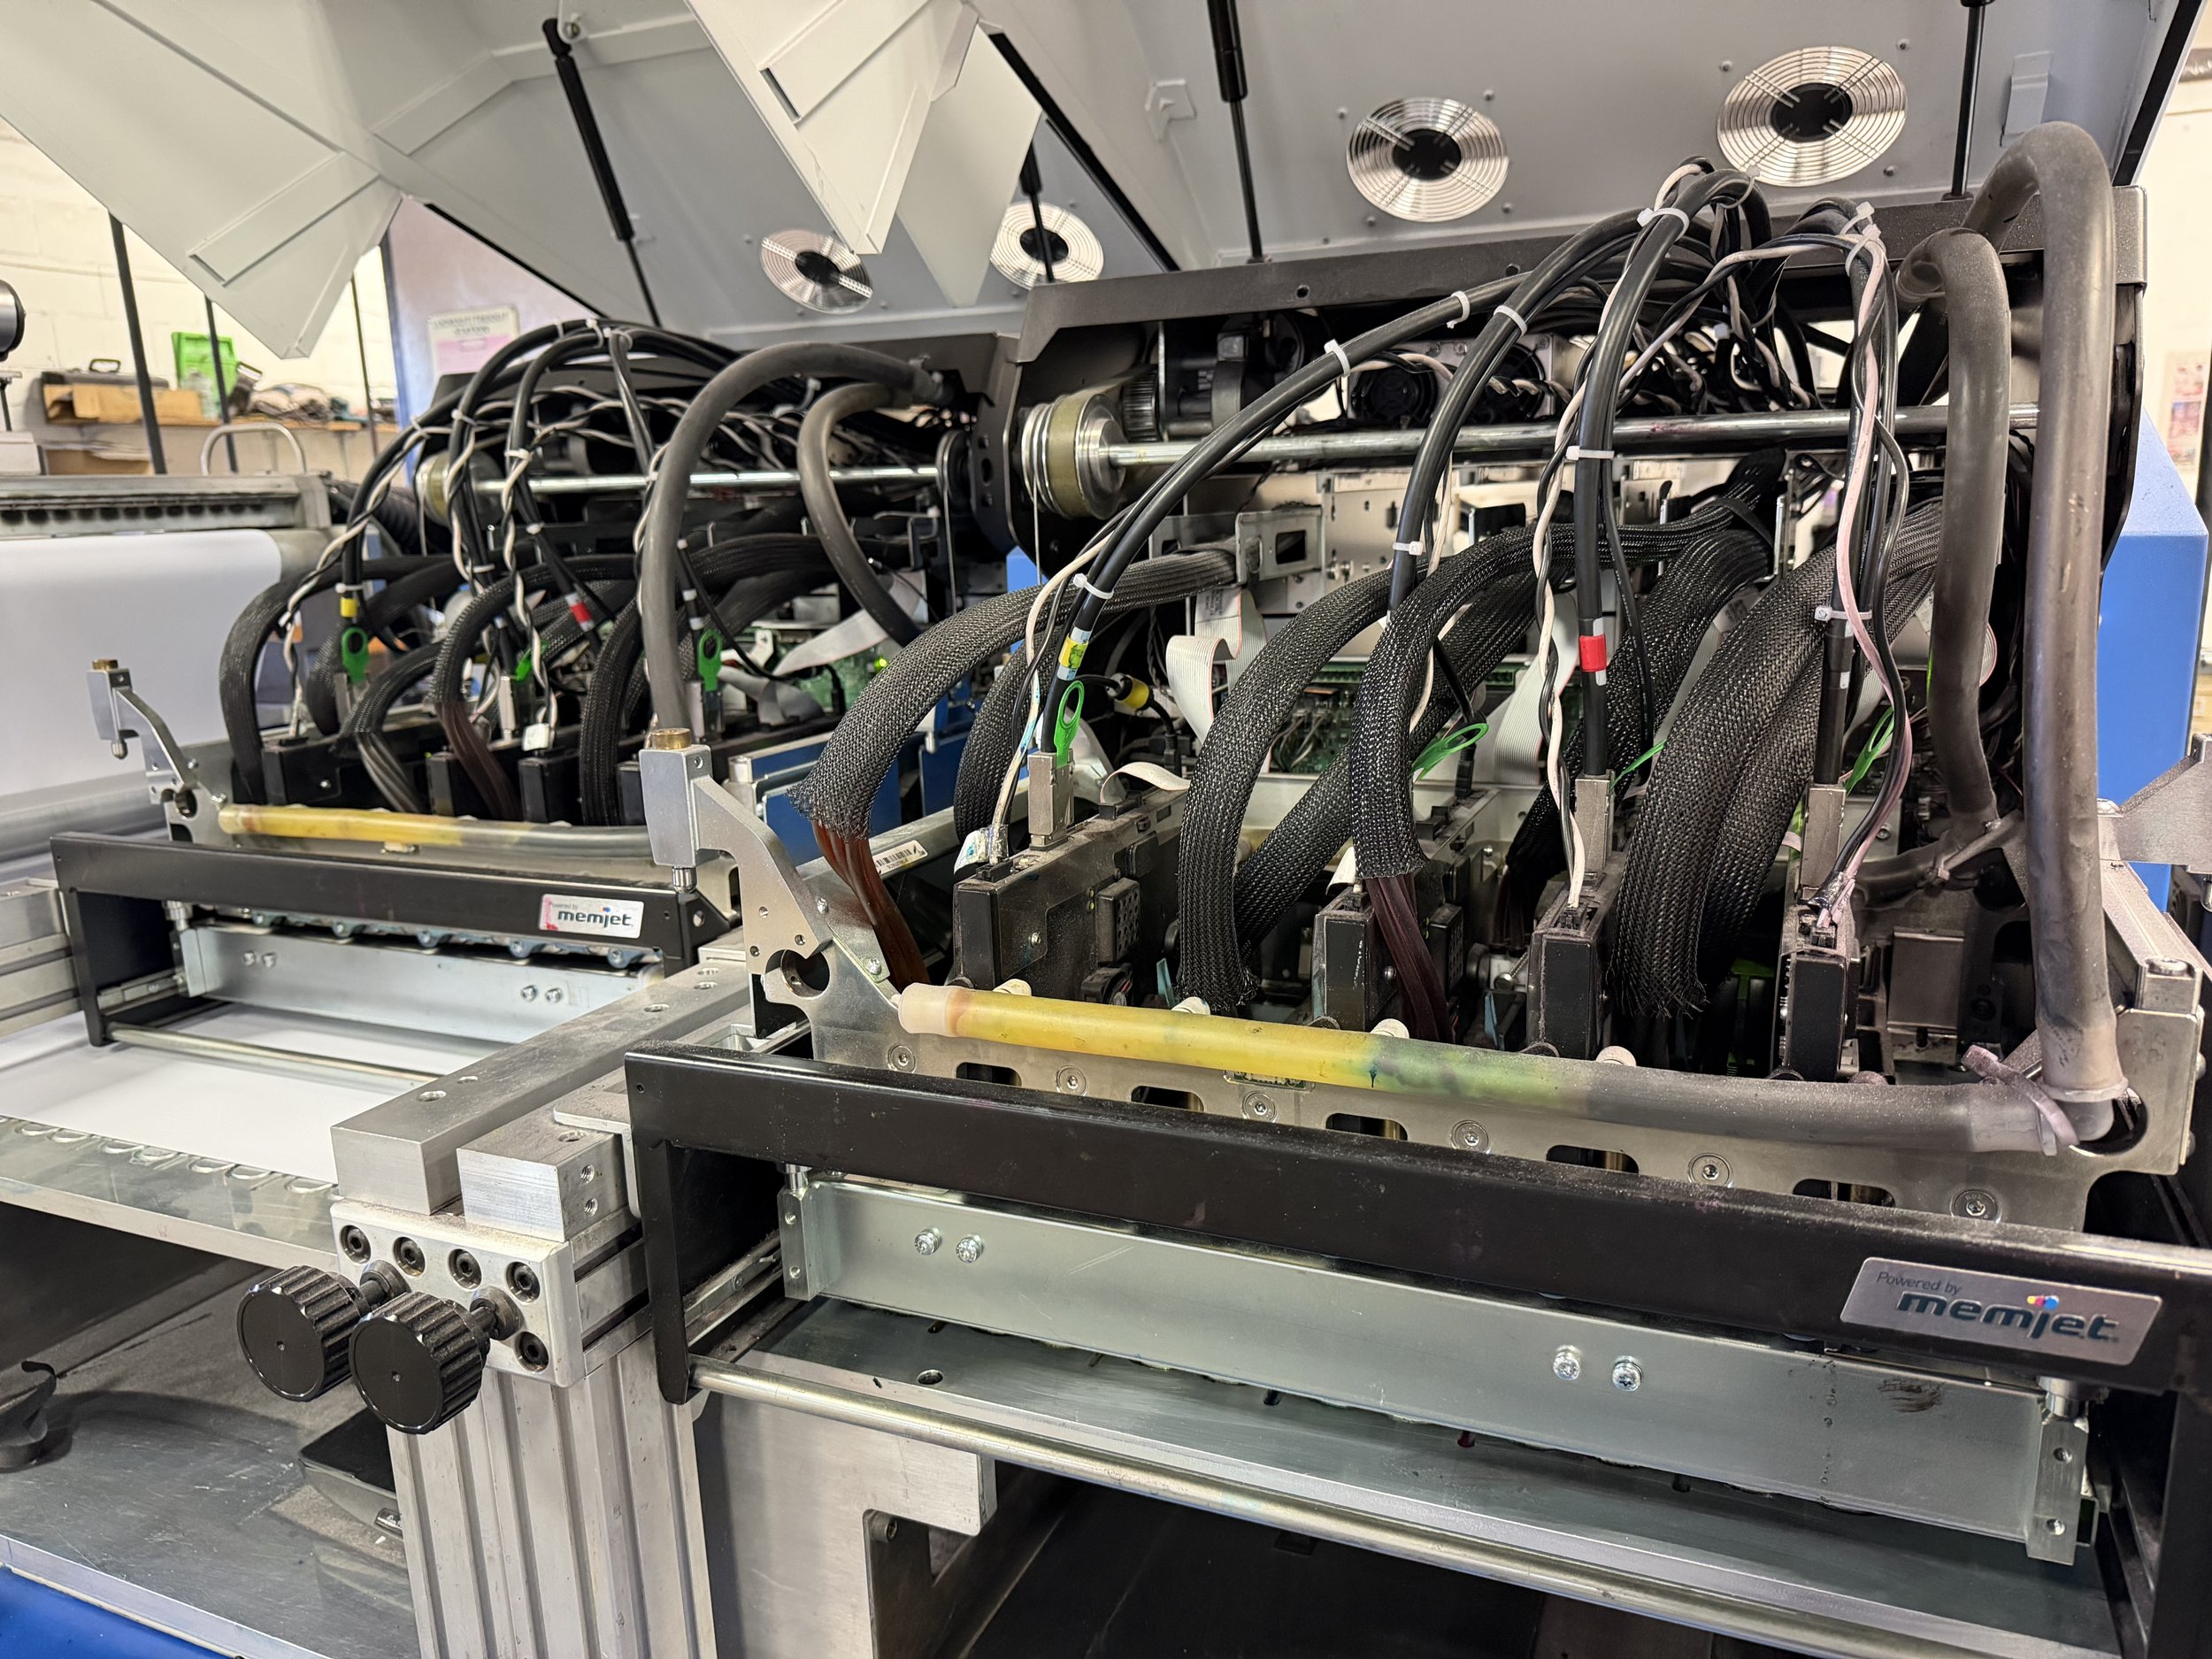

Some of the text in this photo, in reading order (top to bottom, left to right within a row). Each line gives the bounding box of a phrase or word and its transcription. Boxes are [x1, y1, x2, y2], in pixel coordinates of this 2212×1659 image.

[558, 907, 631, 927] memjet
[1877, 1271, 1962, 1296] Powered by
[1897, 1292, 2120, 1340] memjet
